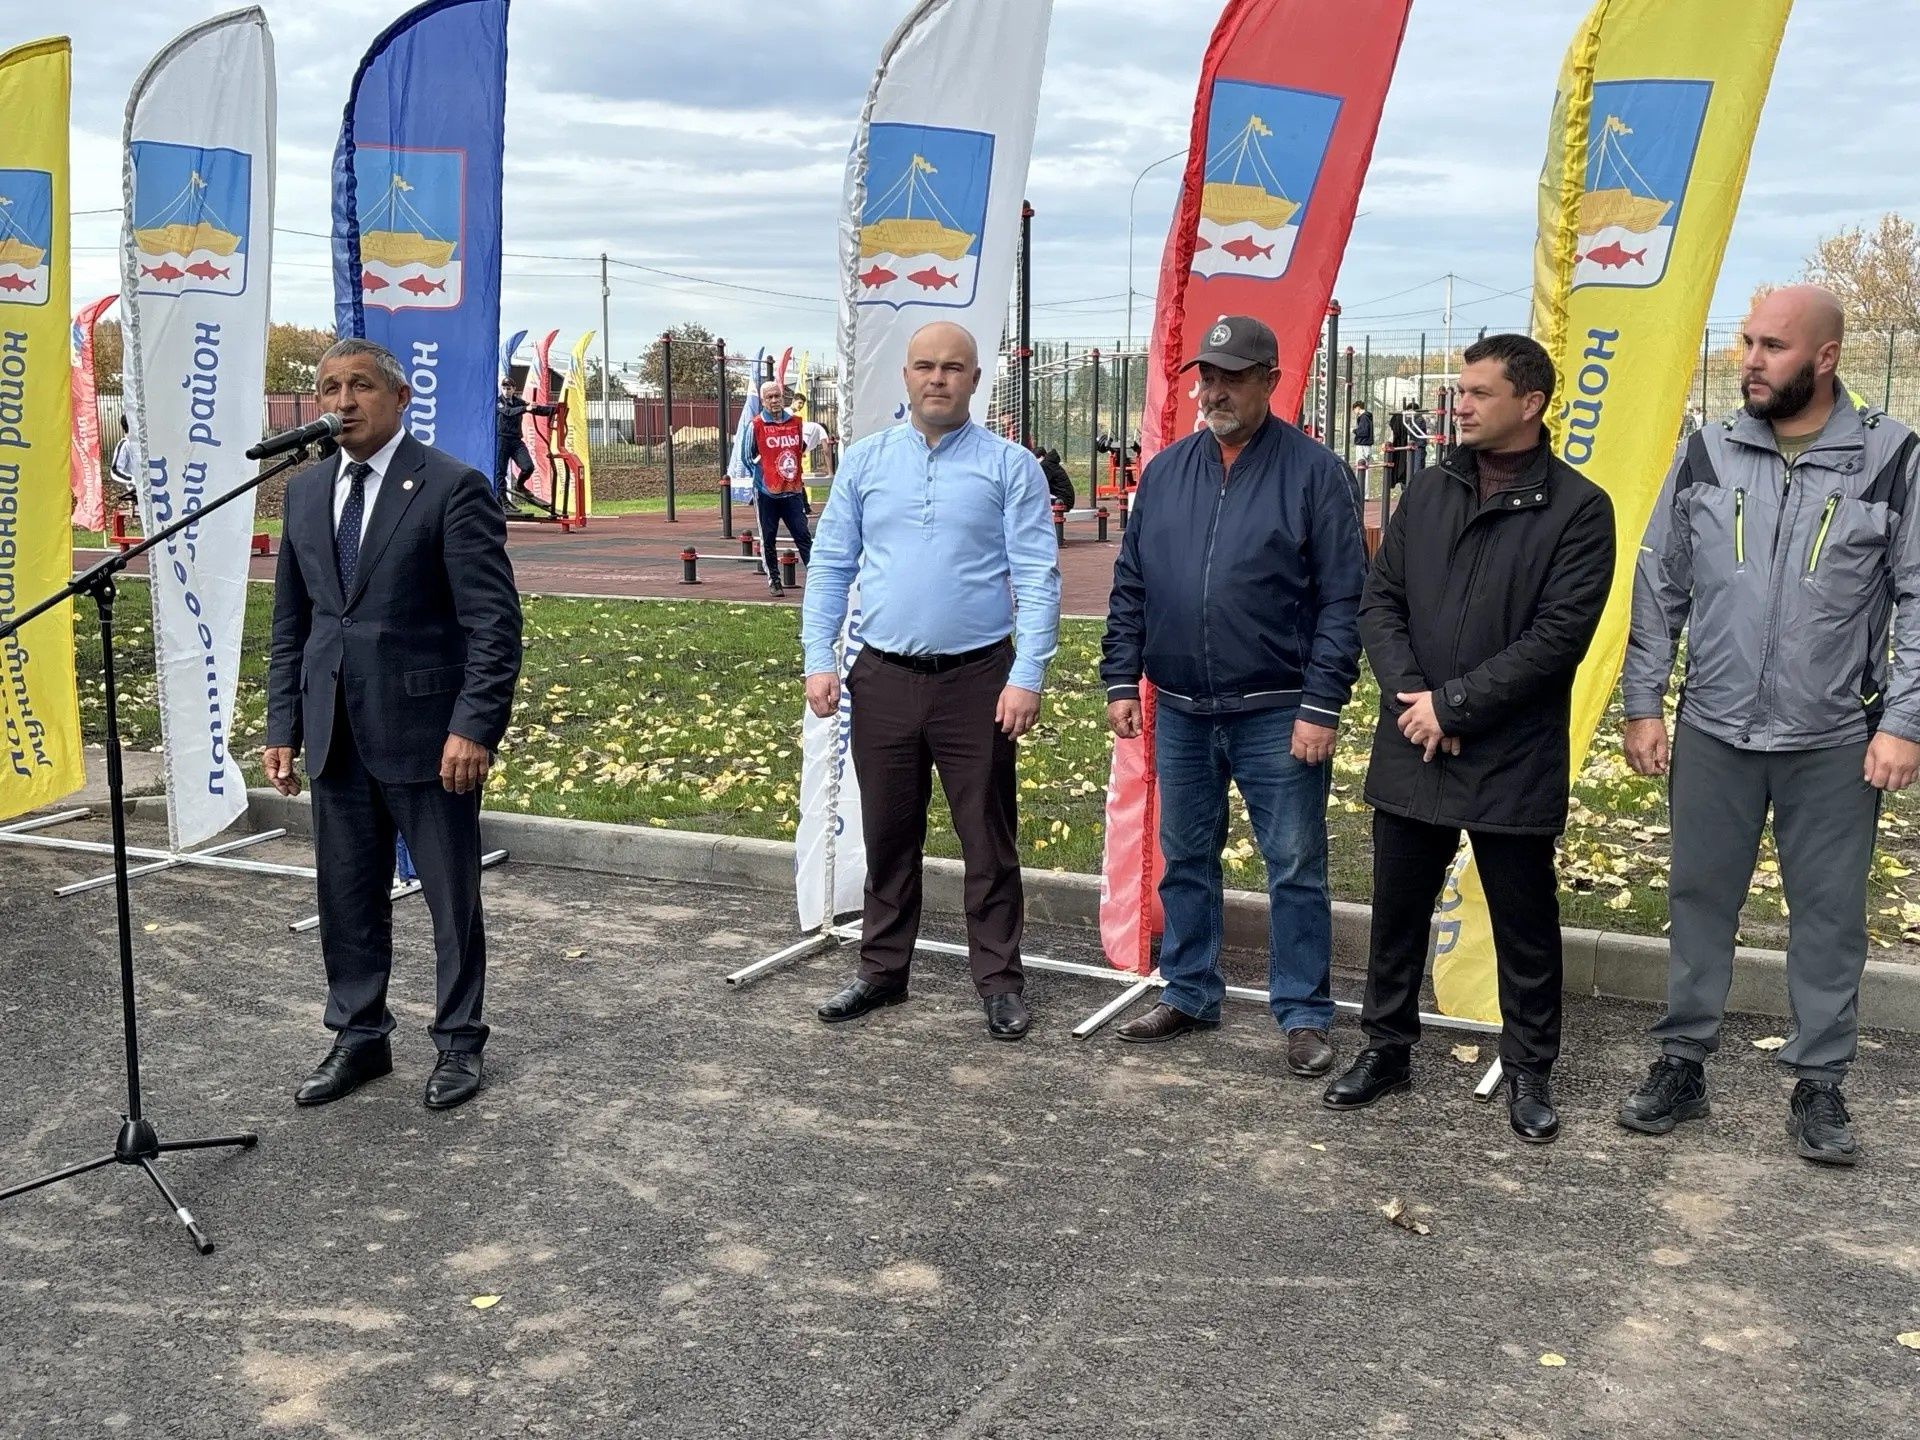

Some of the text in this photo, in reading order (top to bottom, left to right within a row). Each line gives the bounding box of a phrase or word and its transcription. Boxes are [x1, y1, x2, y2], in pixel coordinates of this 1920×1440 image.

[181, 322, 221, 447] район
[405, 341, 439, 446] айон
[1560, 328, 1620, 466] айон
